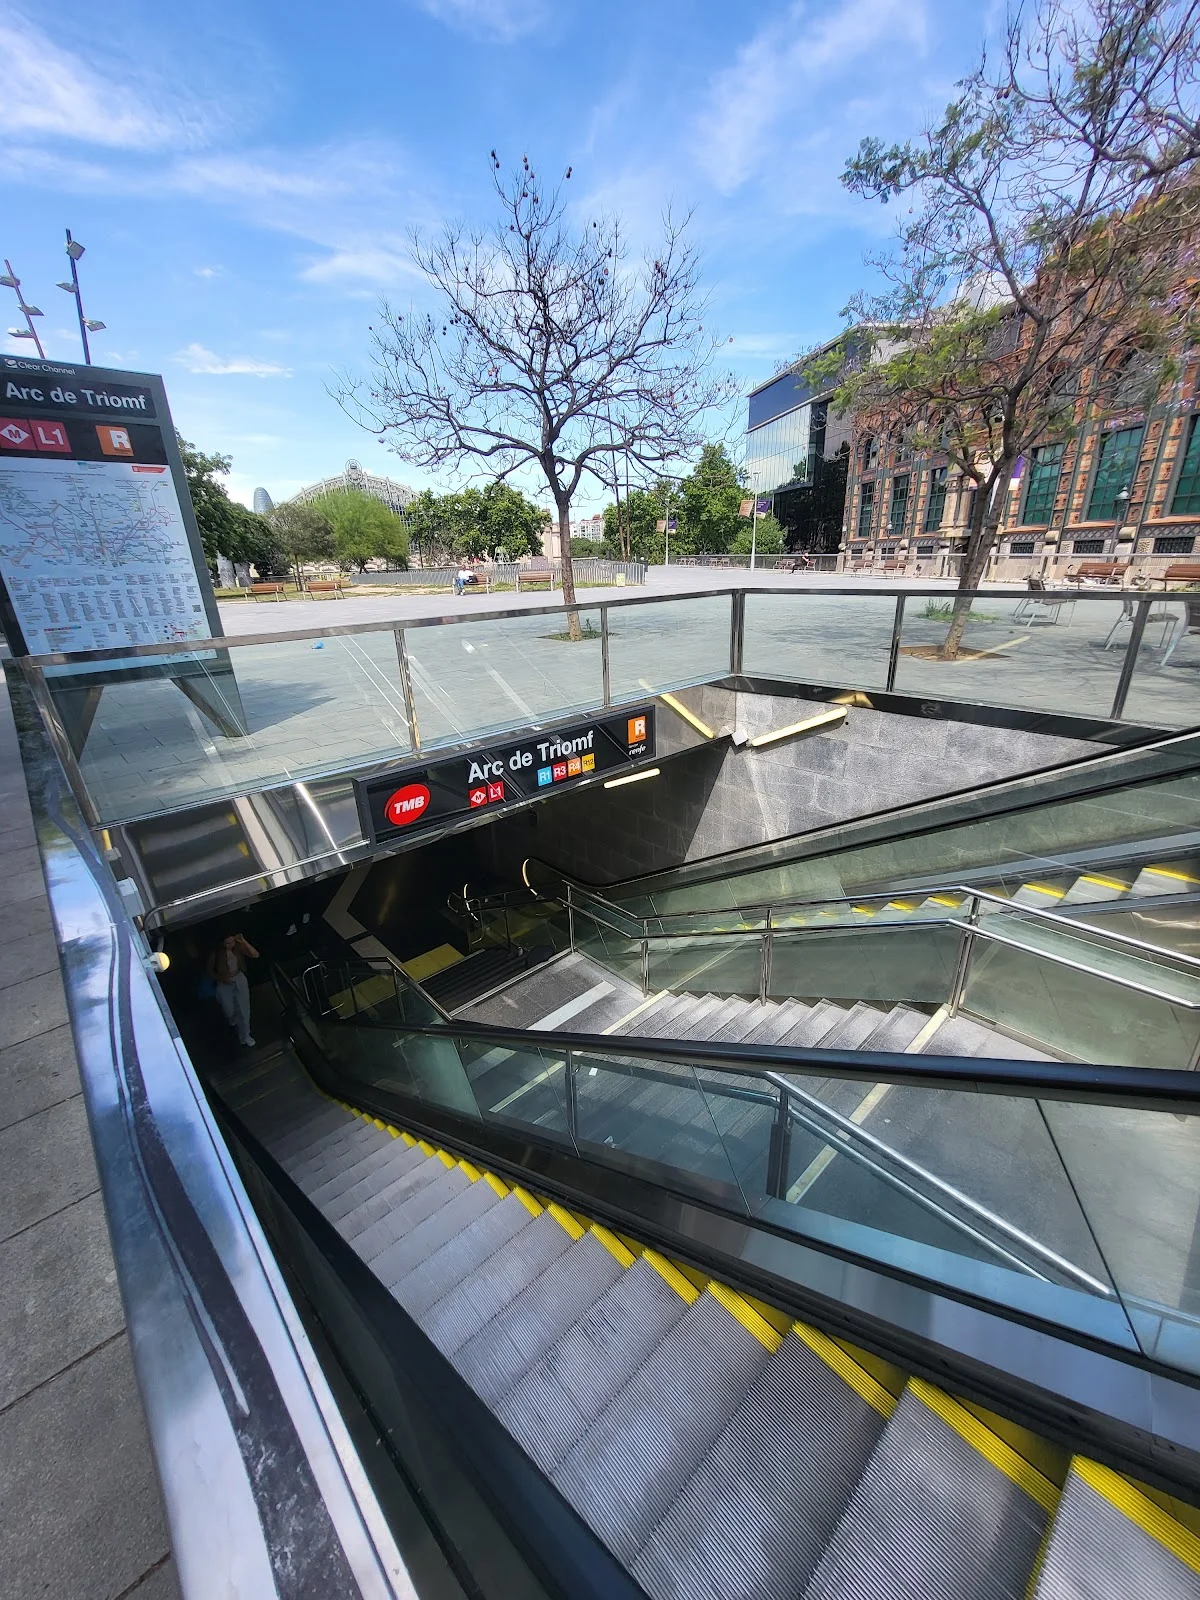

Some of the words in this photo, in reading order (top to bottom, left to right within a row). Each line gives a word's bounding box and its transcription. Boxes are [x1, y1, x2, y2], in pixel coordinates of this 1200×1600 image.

[18, 361, 40, 371] Clear
[41, 364, 76, 375] Channel
[6, 381, 44, 402] Arc
[50, 387, 78, 404] de
[80, 389, 147, 410] Triomf
[7, 429, 22, 439] M
[37, 426, 65, 446] L1
[109, 430, 131, 449] R
[635, 719, 645, 736] R
[468, 760, 504, 784] Arc
[509, 750, 533, 771] de
[536, 730, 594, 762] Triomf
[629, 744, 647, 756] renfe
[539, 771, 552, 783] R1
[553, 766, 566, 778] R3
[568, 762, 581, 773] R4
[583, 757, 595, 767] R12
[490, 785, 502, 799] L1
[394, 796, 425, 815] TMB
